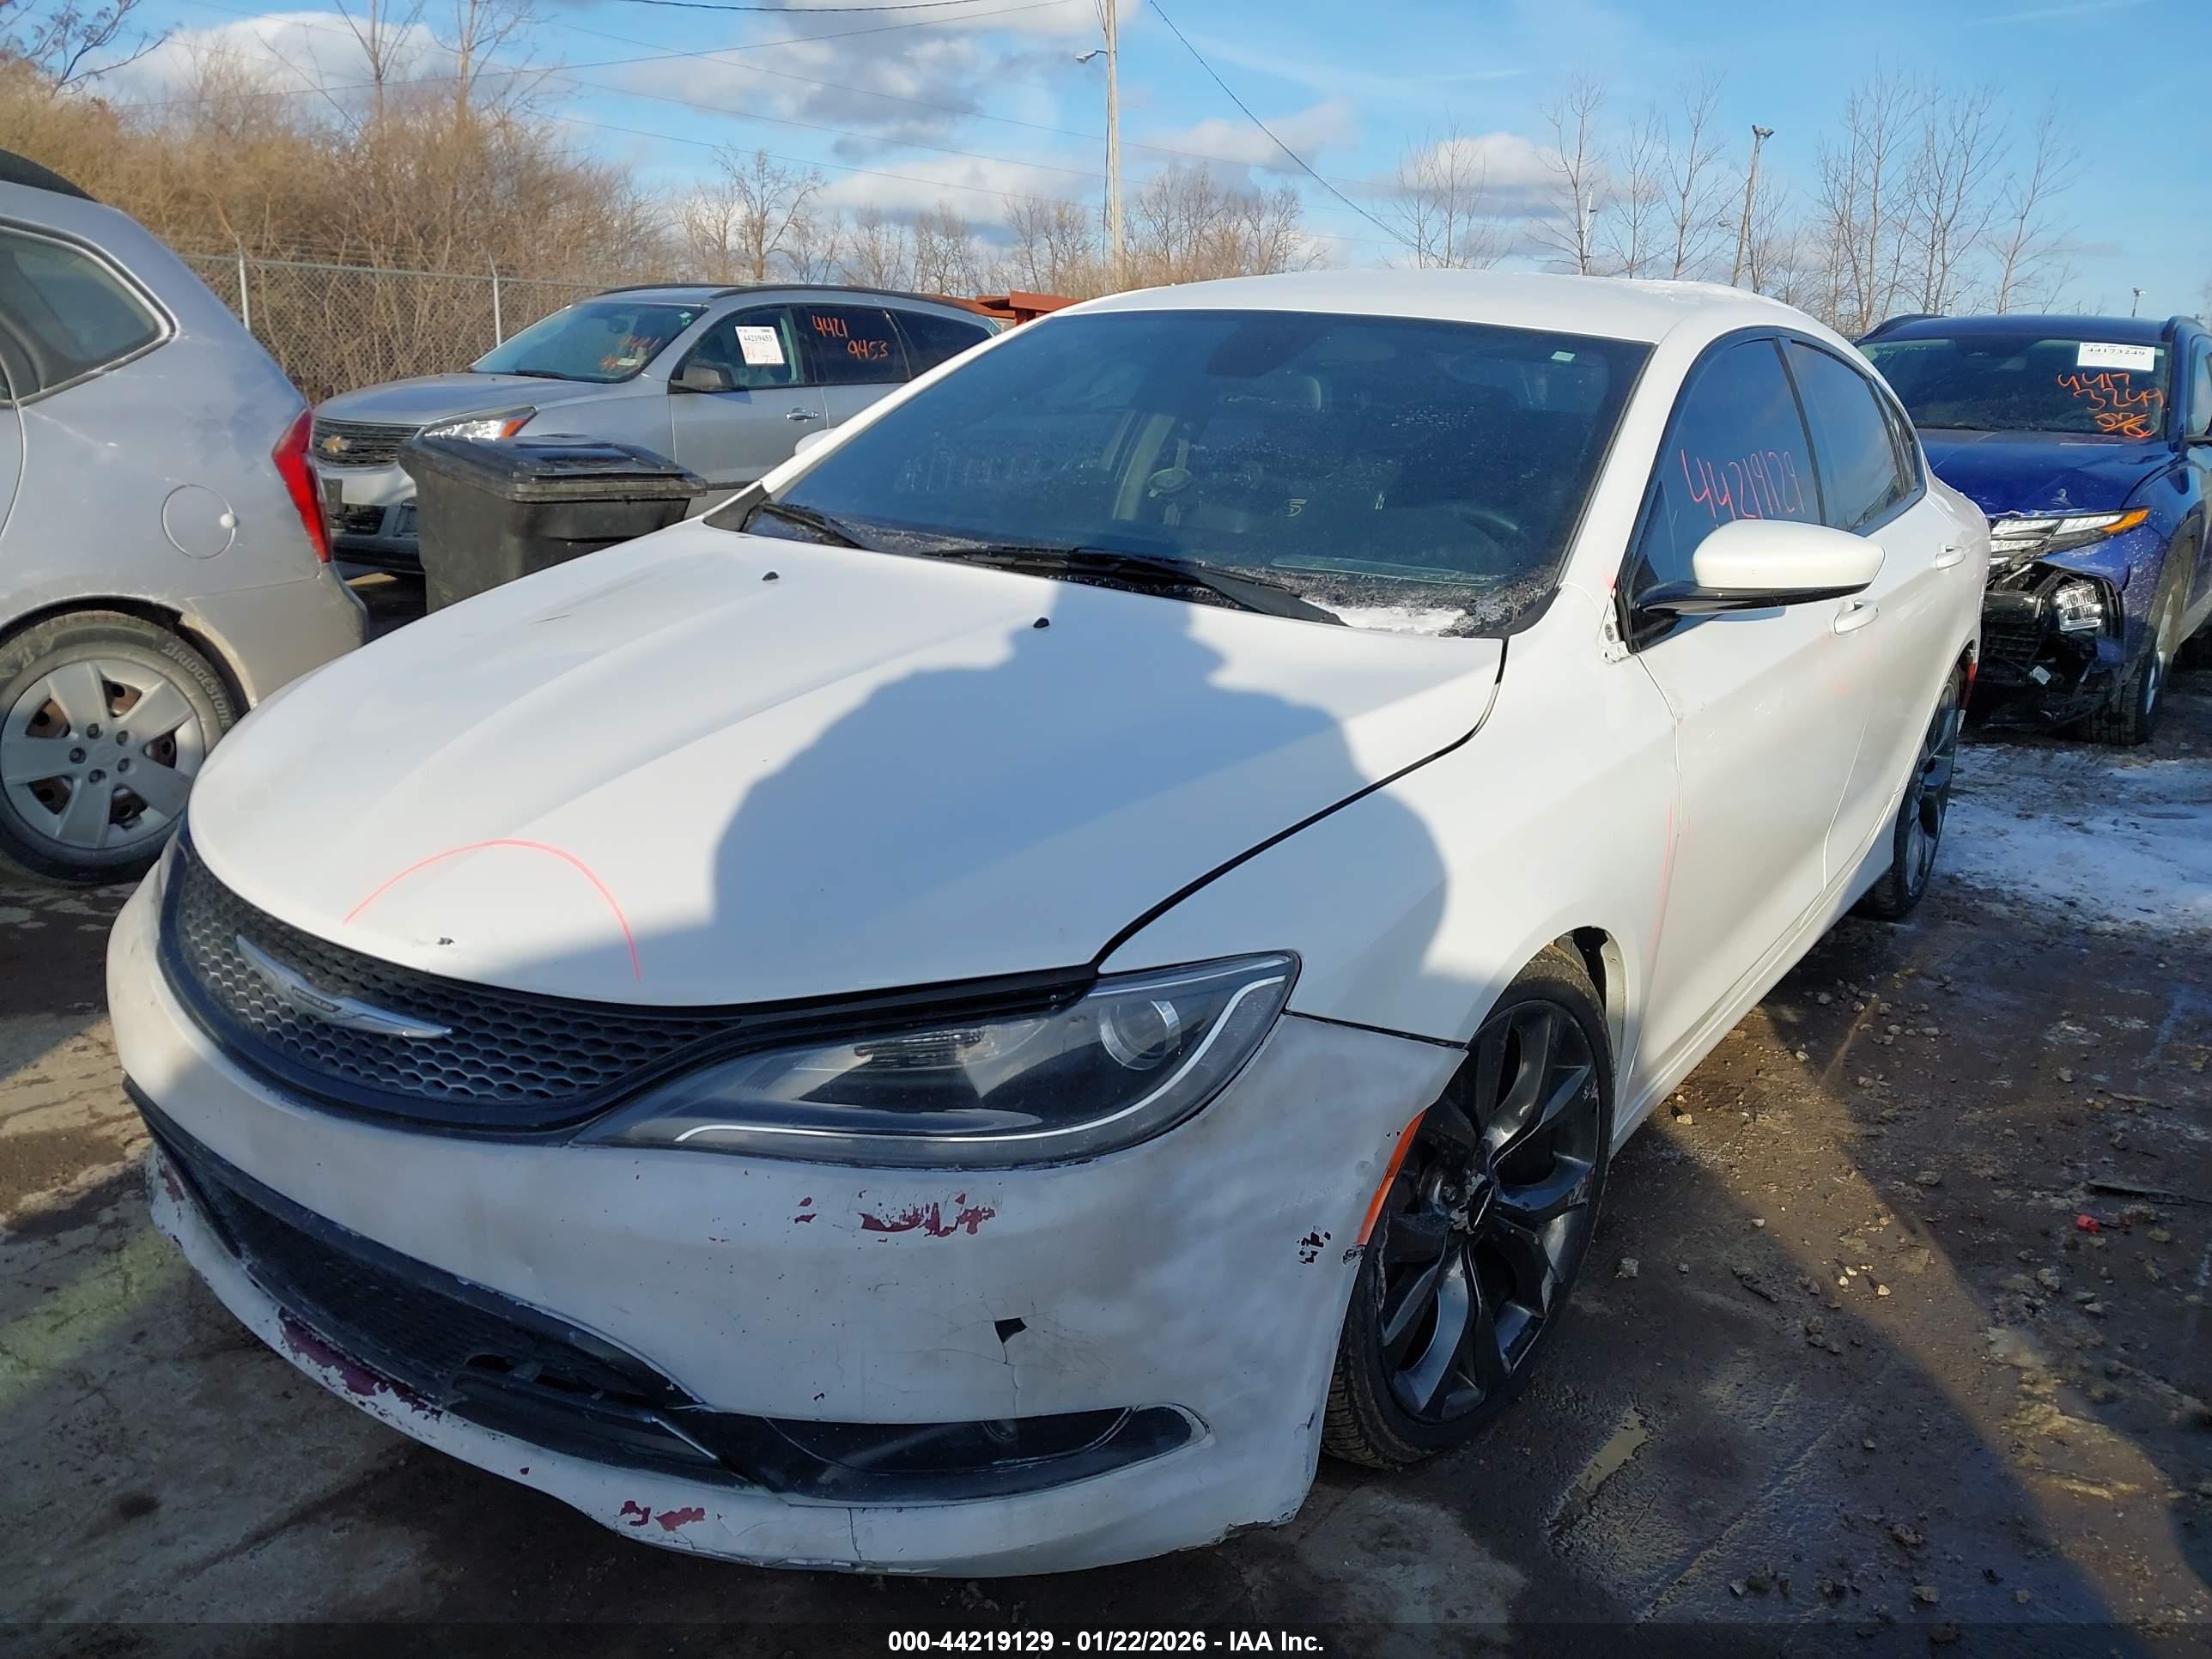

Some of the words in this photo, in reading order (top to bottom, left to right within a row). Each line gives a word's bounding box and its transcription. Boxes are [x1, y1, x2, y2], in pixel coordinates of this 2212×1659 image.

[811, 315, 848, 338] 4421
[848, 339, 888, 361] 9453
[2057, 372, 2130, 390] 4417
[2073, 388, 2164, 410] 3249
[1680, 448, 1806, 521] 44219129
